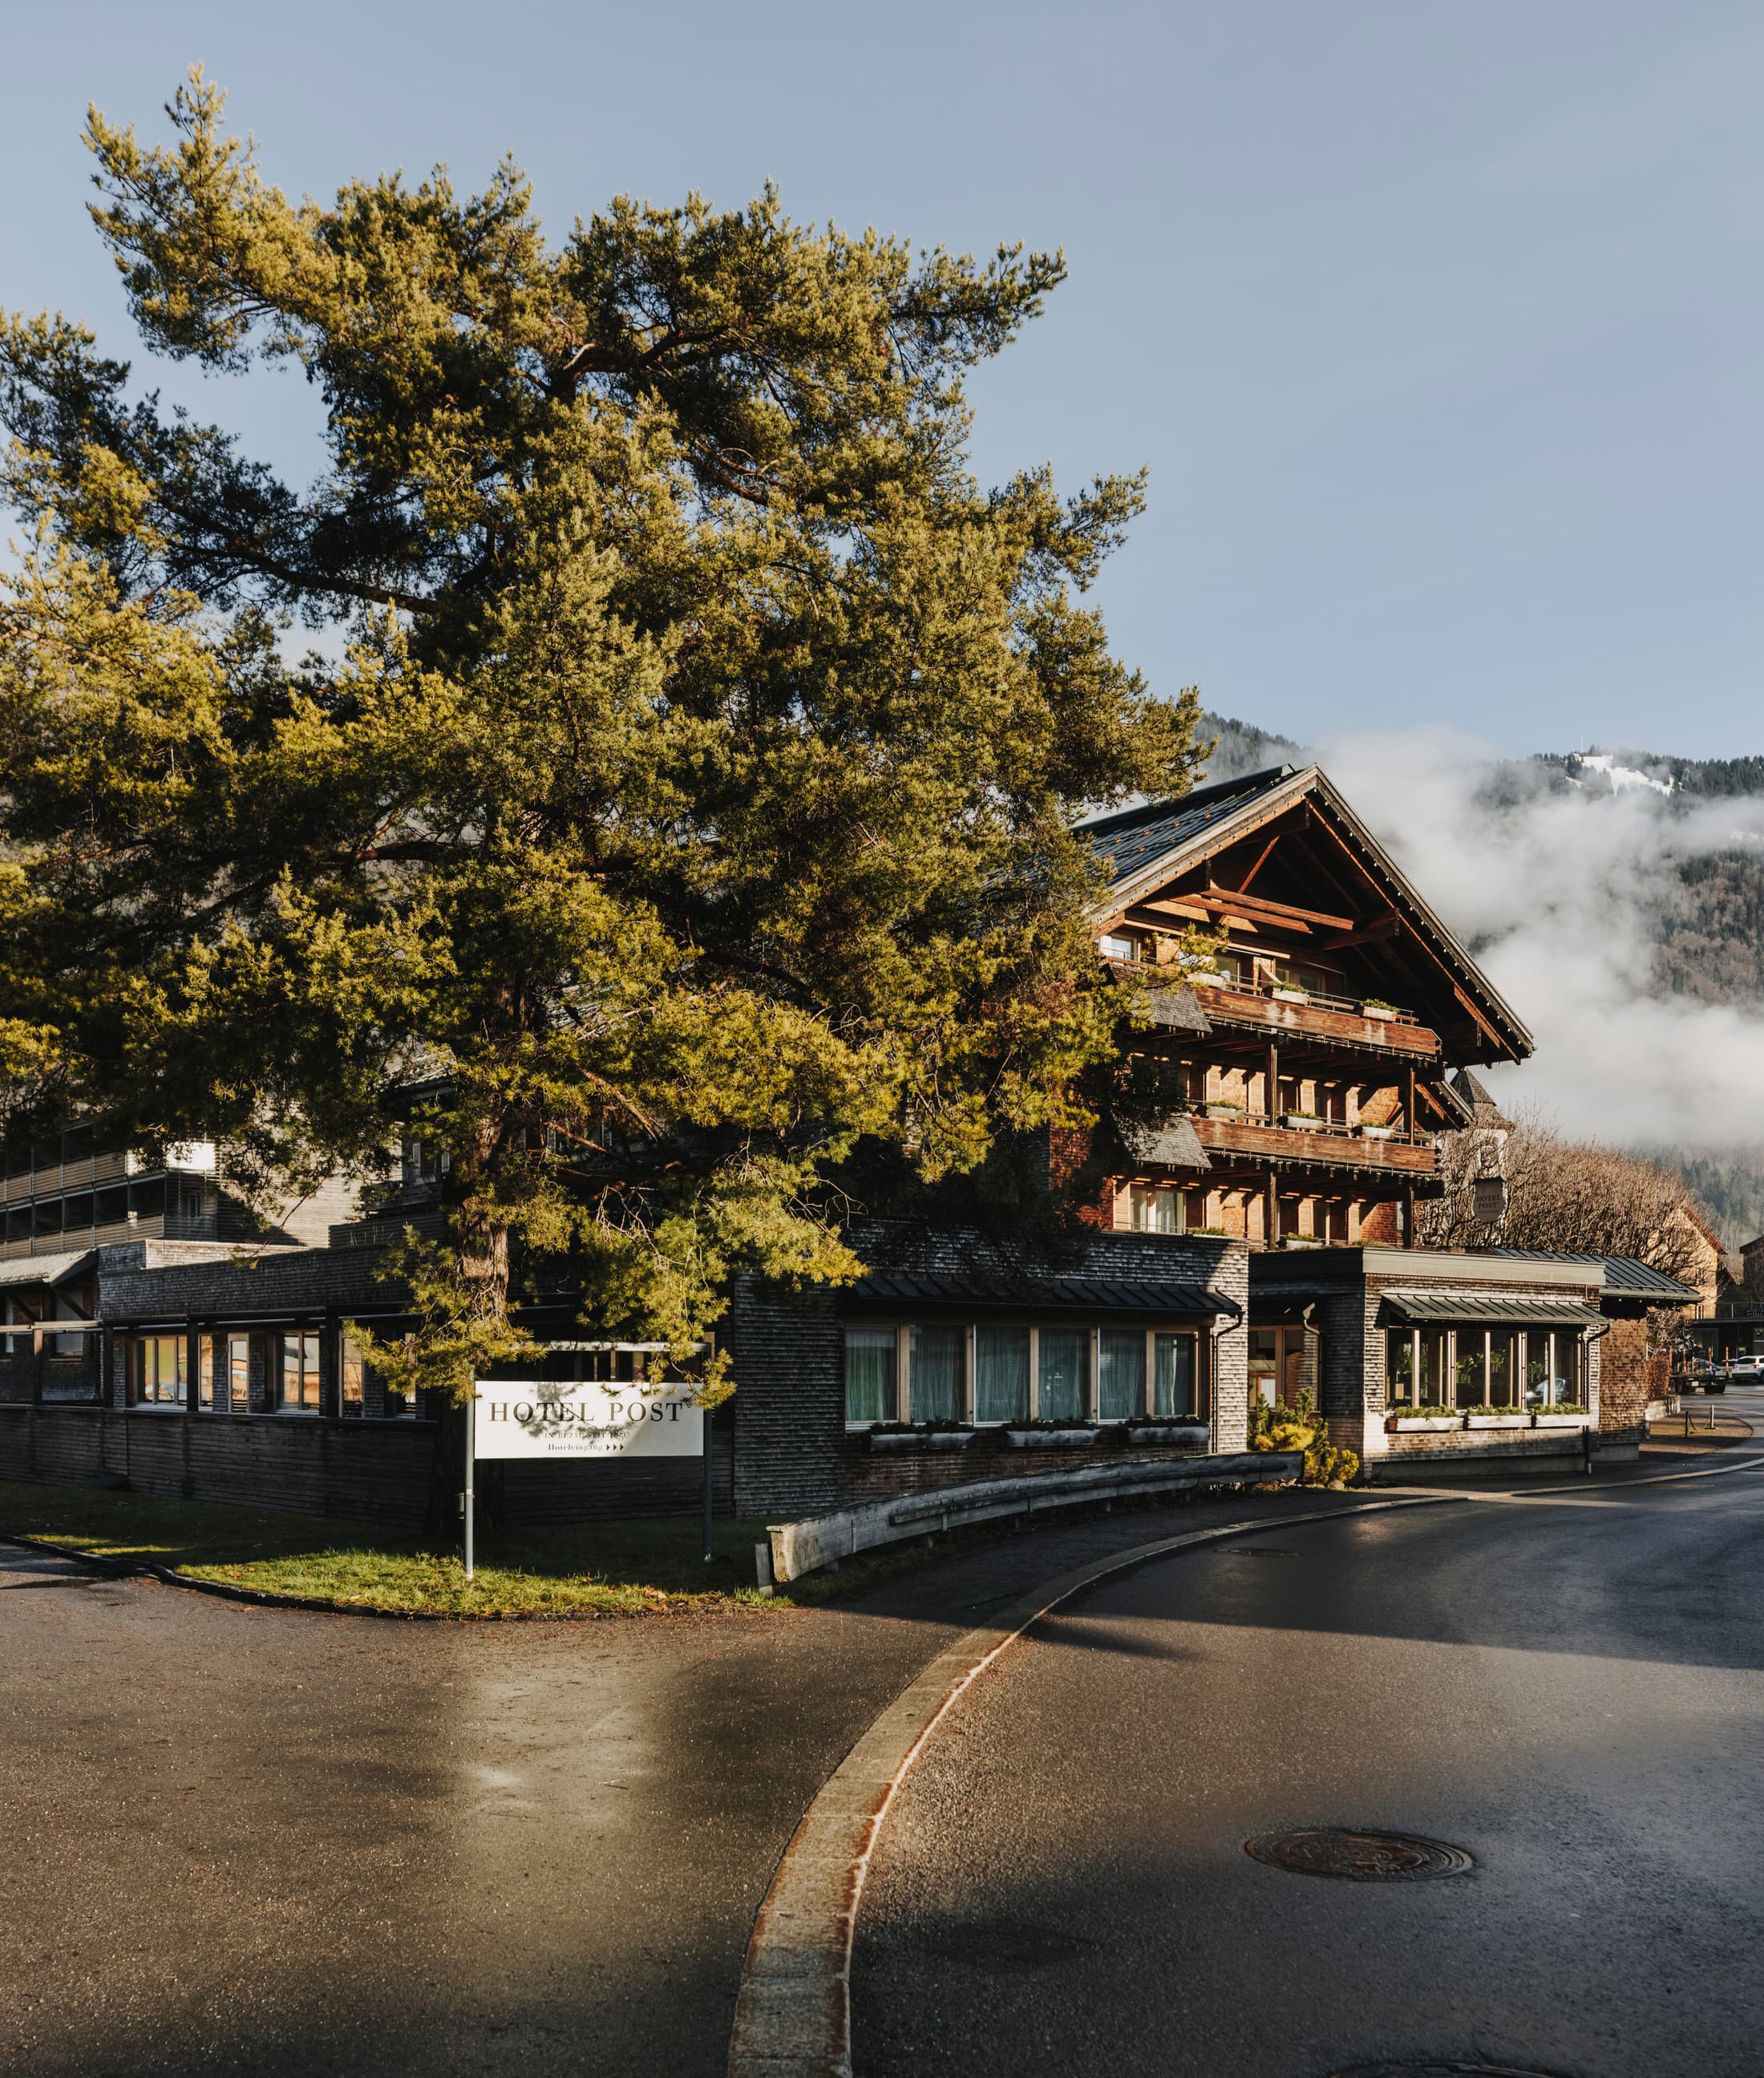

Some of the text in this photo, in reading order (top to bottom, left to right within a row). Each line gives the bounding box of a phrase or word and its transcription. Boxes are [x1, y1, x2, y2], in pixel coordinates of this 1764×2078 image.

[1476, 1194, 1502, 1202] HOTEL
[488, 1402, 683, 1423] HOTEL POST
[548, 1443, 603, 1452] Hoteleingang
